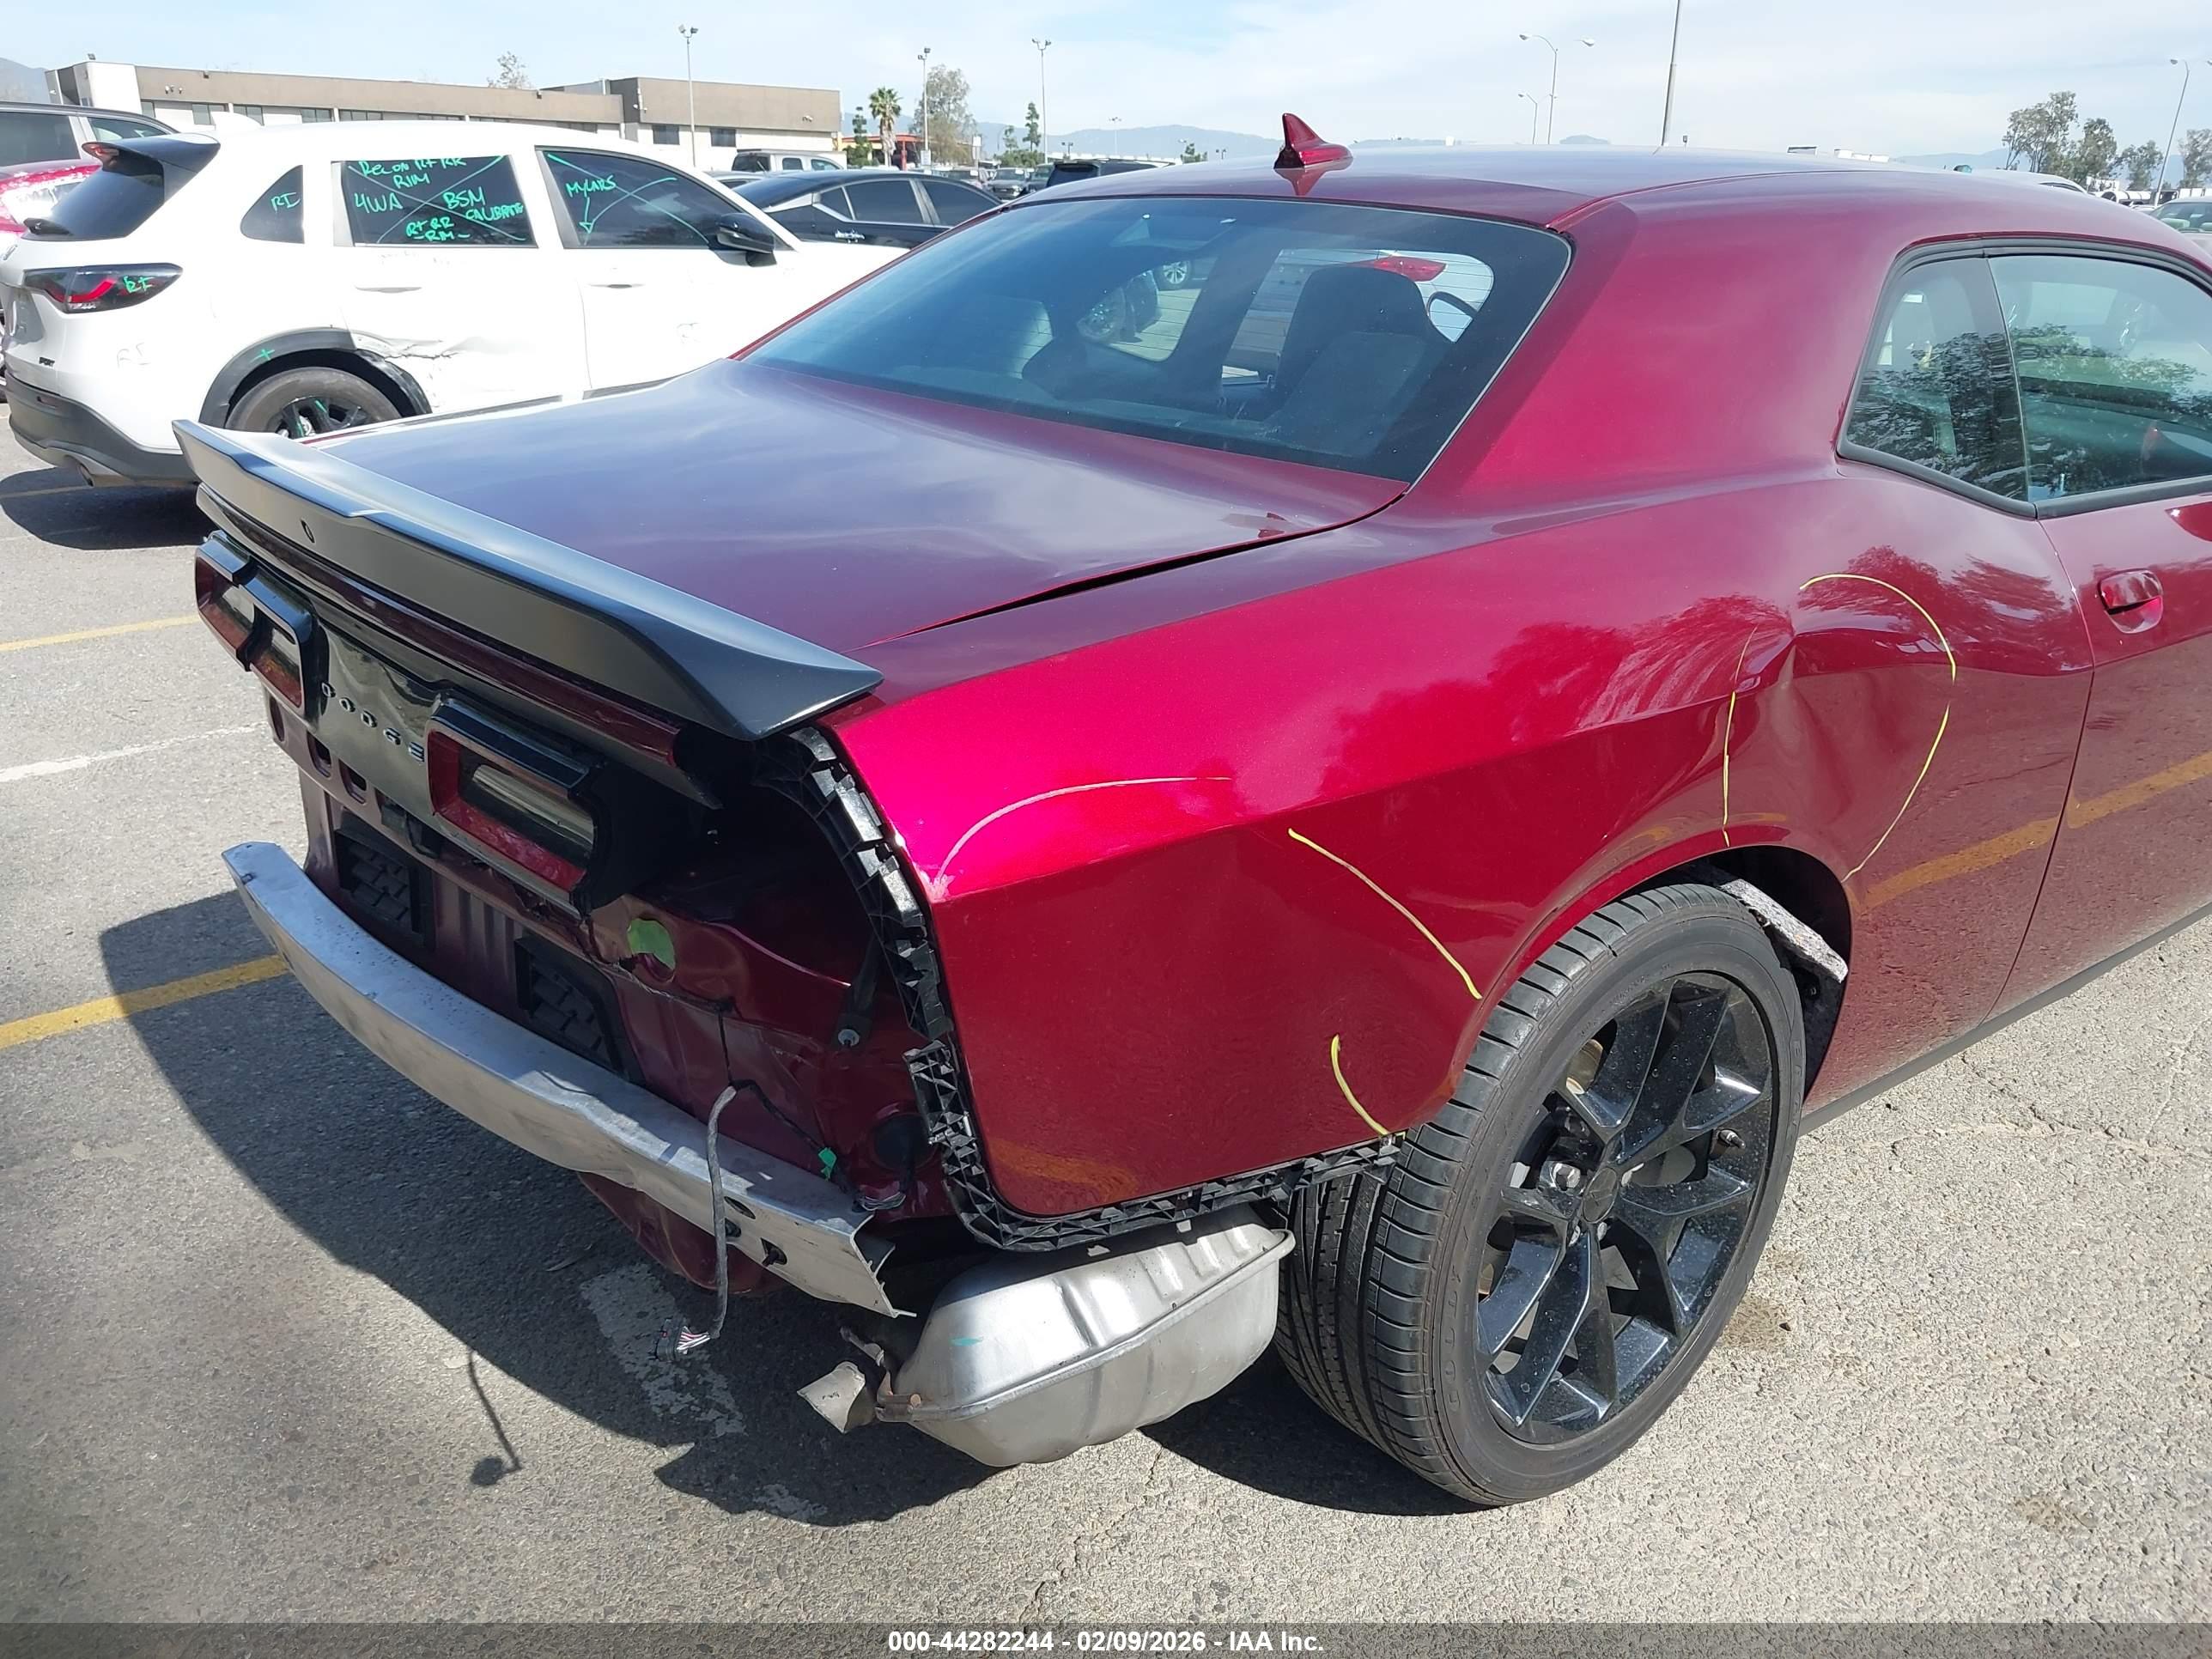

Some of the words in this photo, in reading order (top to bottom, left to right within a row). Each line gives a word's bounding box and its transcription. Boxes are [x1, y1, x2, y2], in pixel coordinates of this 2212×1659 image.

[393, 173, 430, 189] RIM
[354, 191, 404, 214] 4WA
[442, 185, 485, 210] BSM
[321, 682, 425, 763] DODGE
